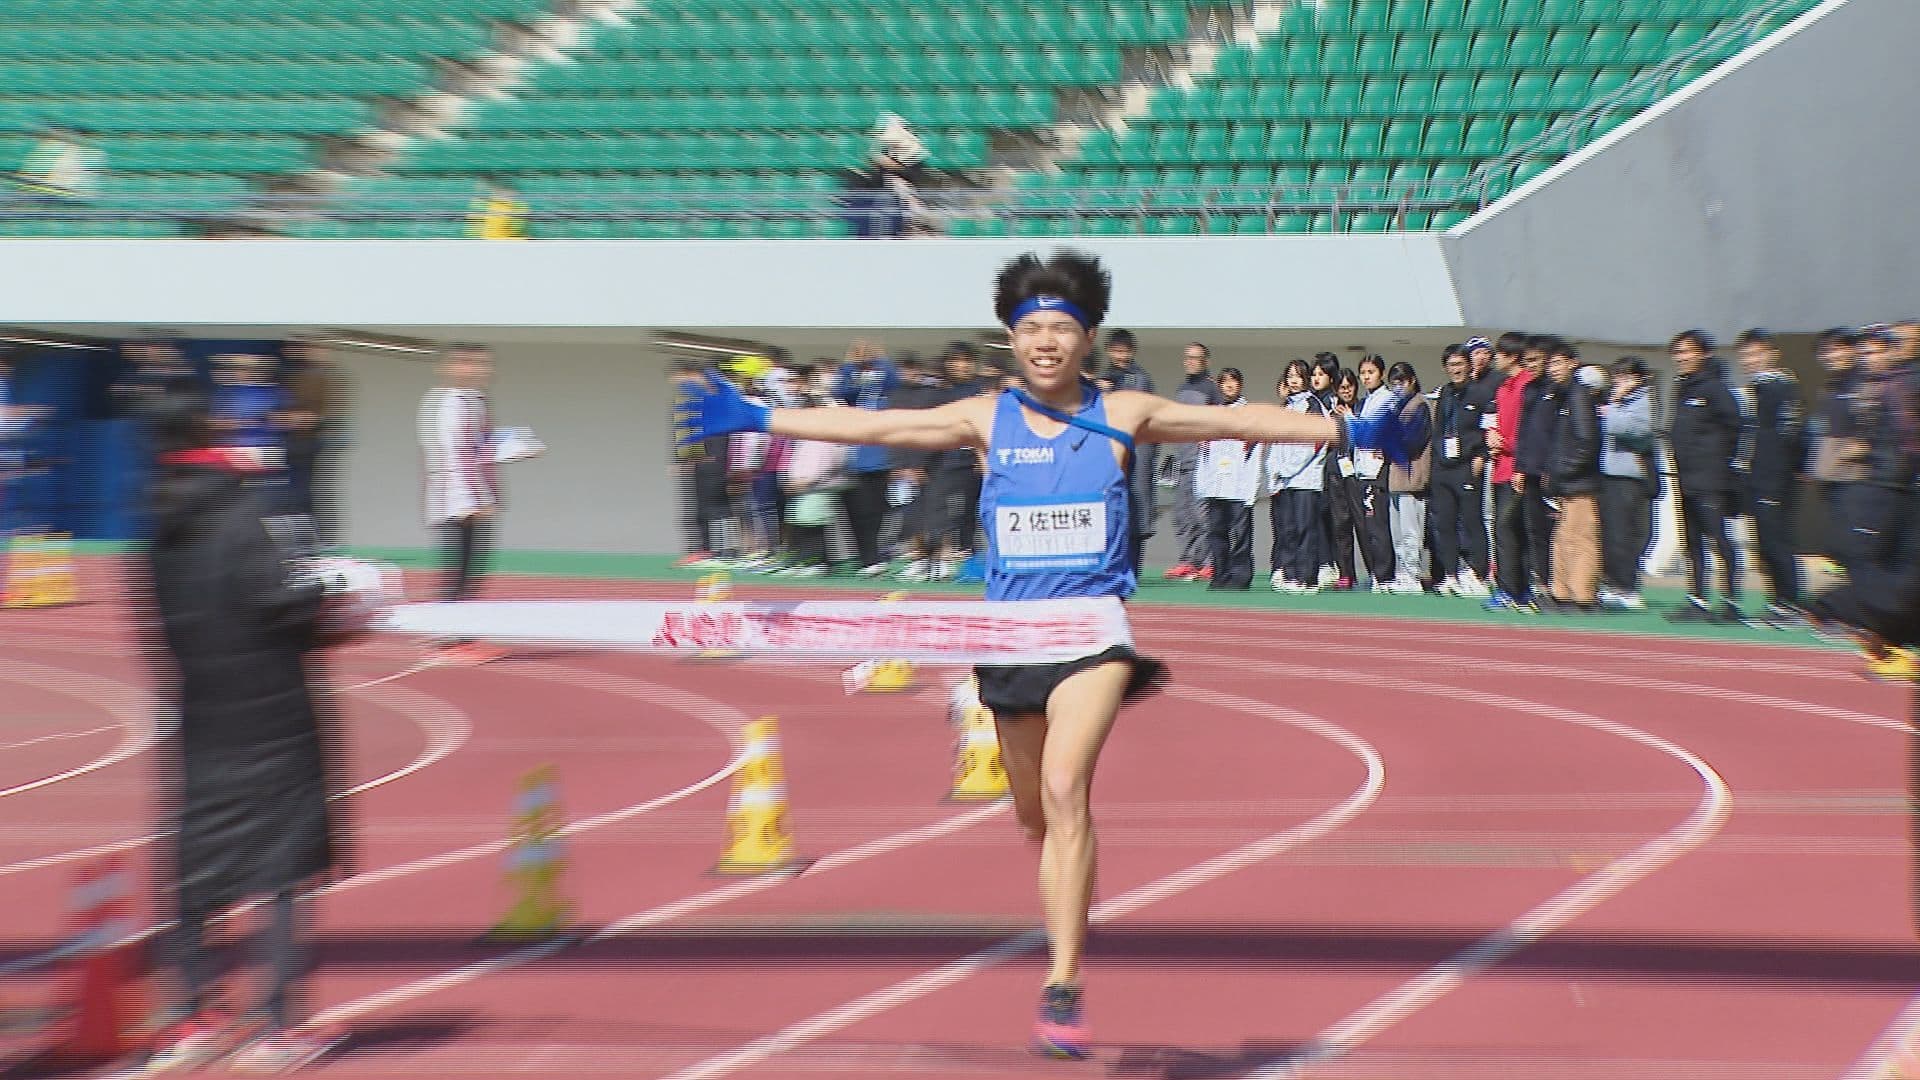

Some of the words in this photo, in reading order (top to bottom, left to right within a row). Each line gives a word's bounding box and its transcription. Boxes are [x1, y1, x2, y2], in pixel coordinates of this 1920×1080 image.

[1014, 447, 1054, 458] TOKAI
[1009, 512, 1021, 531] 2
[1029, 508, 1092, 531] 佐世保
